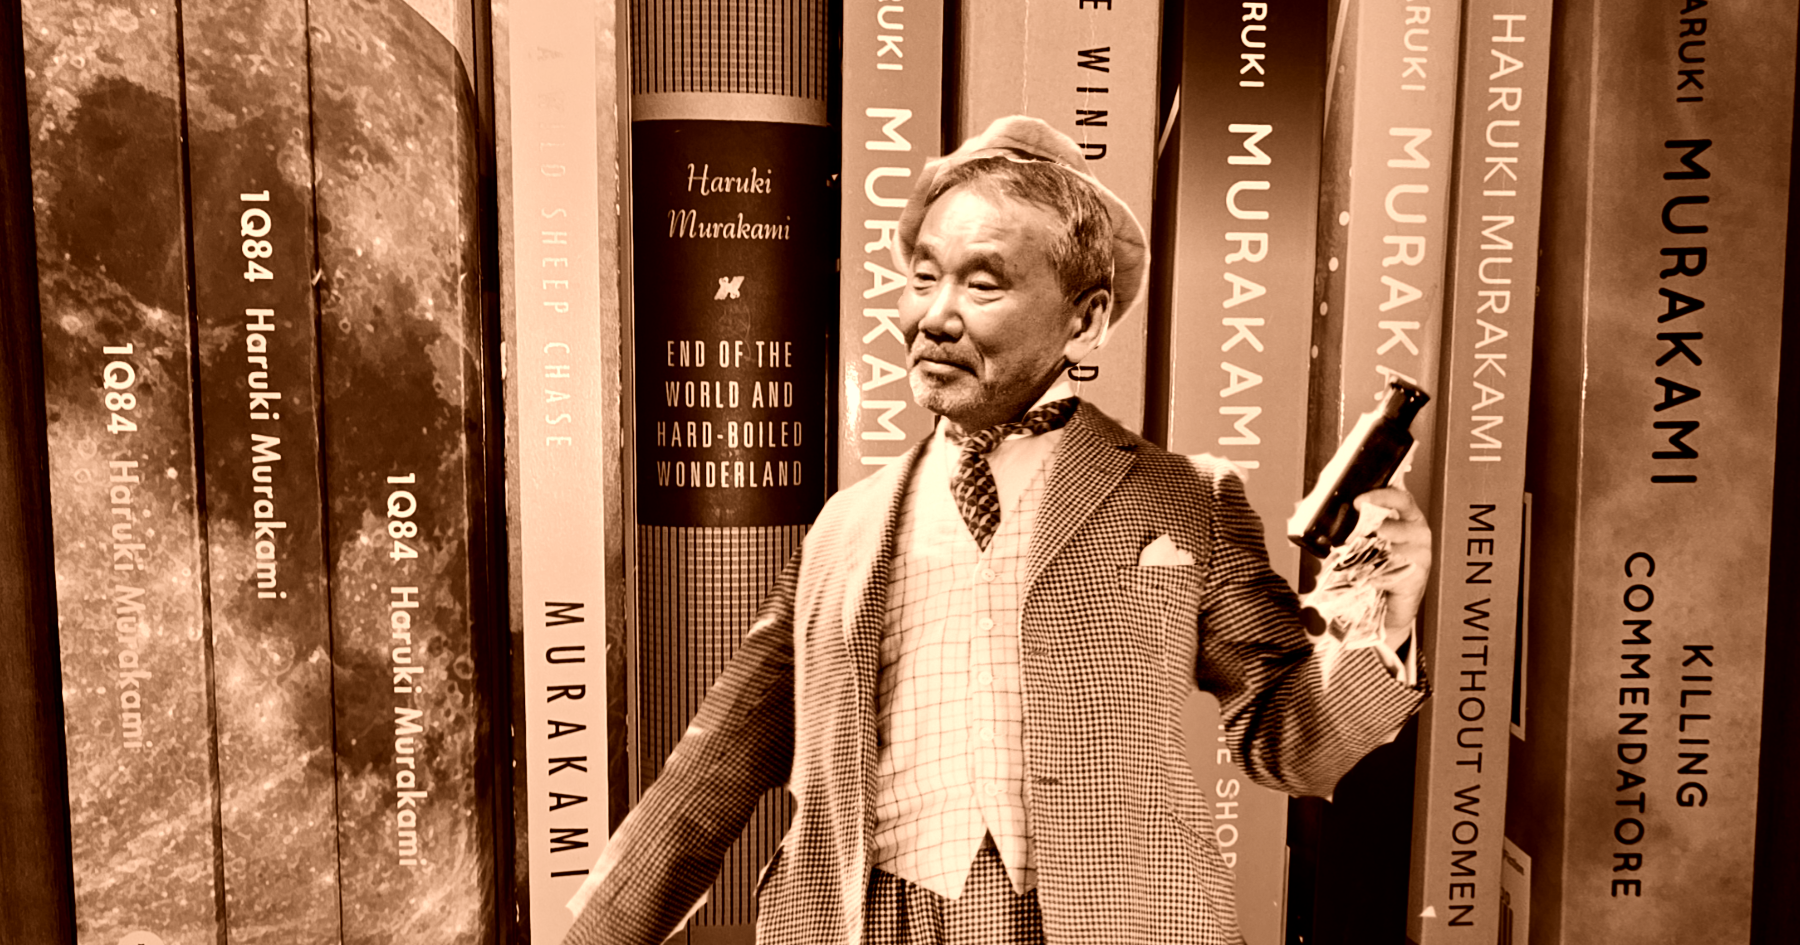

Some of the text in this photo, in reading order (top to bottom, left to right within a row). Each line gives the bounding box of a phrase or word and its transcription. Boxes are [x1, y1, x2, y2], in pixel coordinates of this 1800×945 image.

[668, 209, 791, 240] Murakami
[687, 163, 772, 196] Haruki
[862, 0, 913, 465] UKI MURAKAMI
[1076, 47, 1110, 160] WIND
[1218, 3, 1272, 469] RUKI MURAKAMI
[1374, 0, 1432, 398] RUKI MURAKA
[1470, 15, 1526, 461] HARUKI MURAKAMI
[241, 190, 287, 599] 1Q84 Haruki Murakami
[542, 209, 568, 313] SHEEP
[544, 343, 571, 446] CHASE
[666, 381, 792, 408] WORLD AND
[668, 341, 791, 367] END OF THE
[1651, 139, 1712, 483] MURAKAMI
[103, 343, 153, 750] 1Q84 Haruki Murakami
[657, 421, 802, 448] HARD-BOILED
[657, 460, 802, 488] WONDERLAND
[387, 473, 428, 867] 1Q84 Haruki Murakami
[545, 602, 589, 877] MURAKAMI
[1448, 505, 1496, 926] MEN WITHOUT WOMEN
[1611, 552, 1656, 897] COMMENDATORE
[1676, 645, 1714, 807] KILLING
